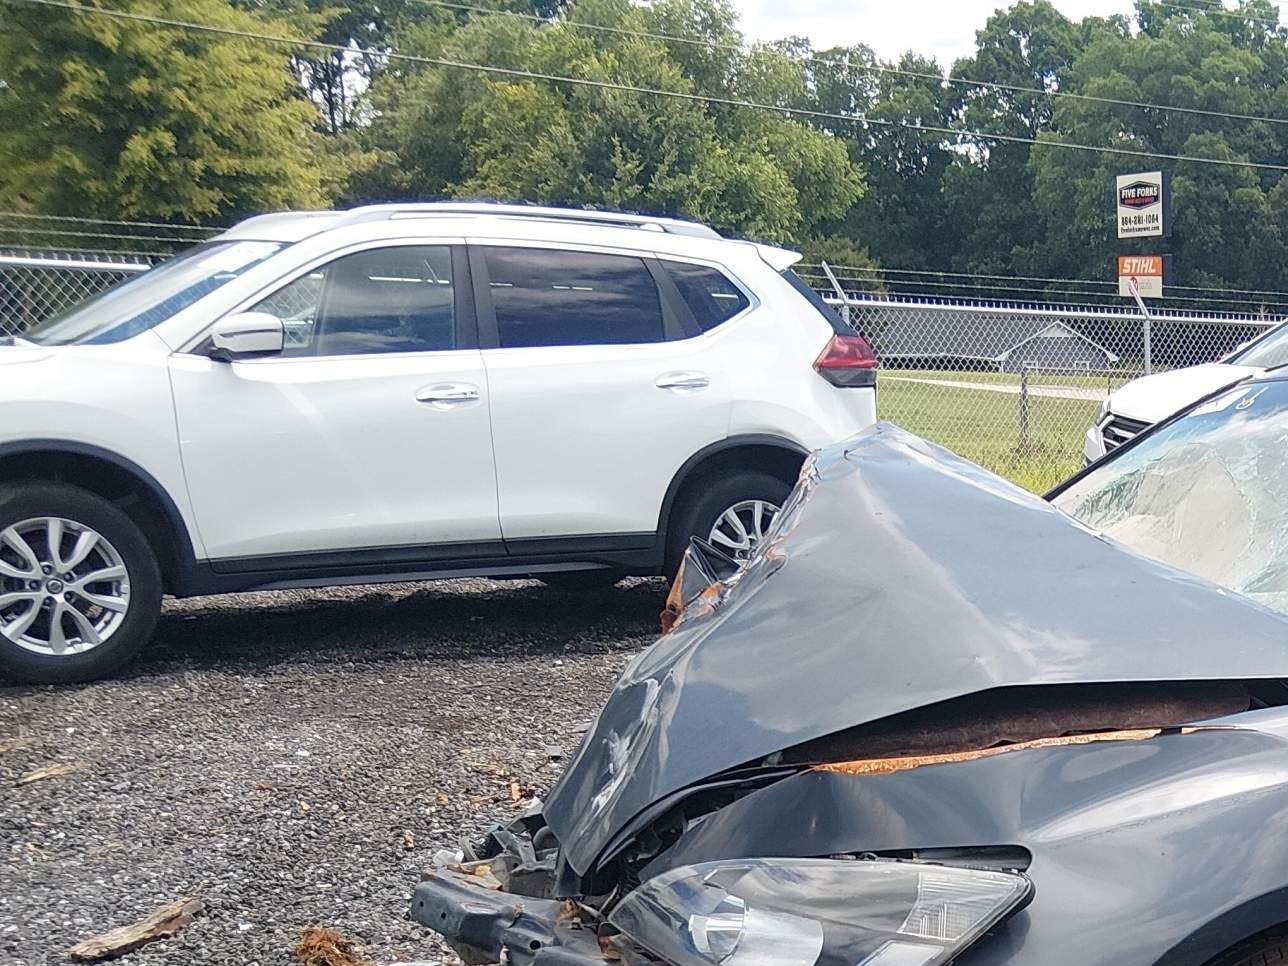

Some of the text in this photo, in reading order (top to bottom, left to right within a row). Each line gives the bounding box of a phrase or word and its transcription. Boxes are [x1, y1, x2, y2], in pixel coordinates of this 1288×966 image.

[1121, 187, 1158, 199] FIVE FORKS
[1122, 258, 1157, 273] STIHL
